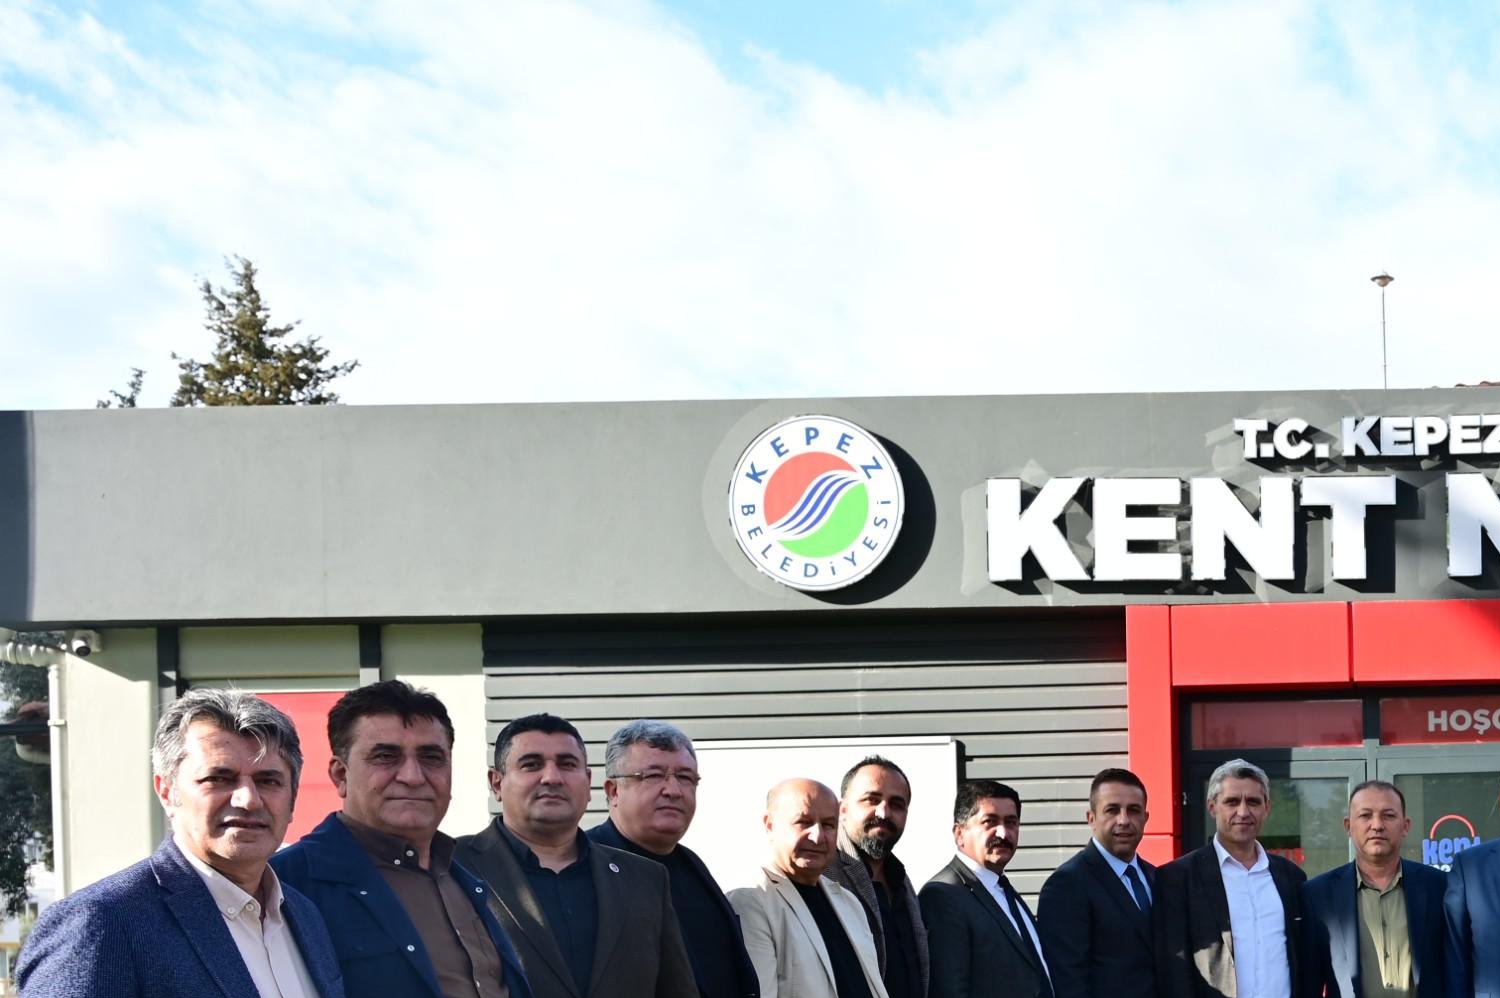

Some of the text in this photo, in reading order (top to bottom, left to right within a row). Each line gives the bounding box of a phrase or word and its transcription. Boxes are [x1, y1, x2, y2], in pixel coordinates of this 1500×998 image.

[745, 427, 883, 485] KEPEZ
[1234, 417, 1330, 459] T.C.
[986, 475, 1397, 581] KENT
